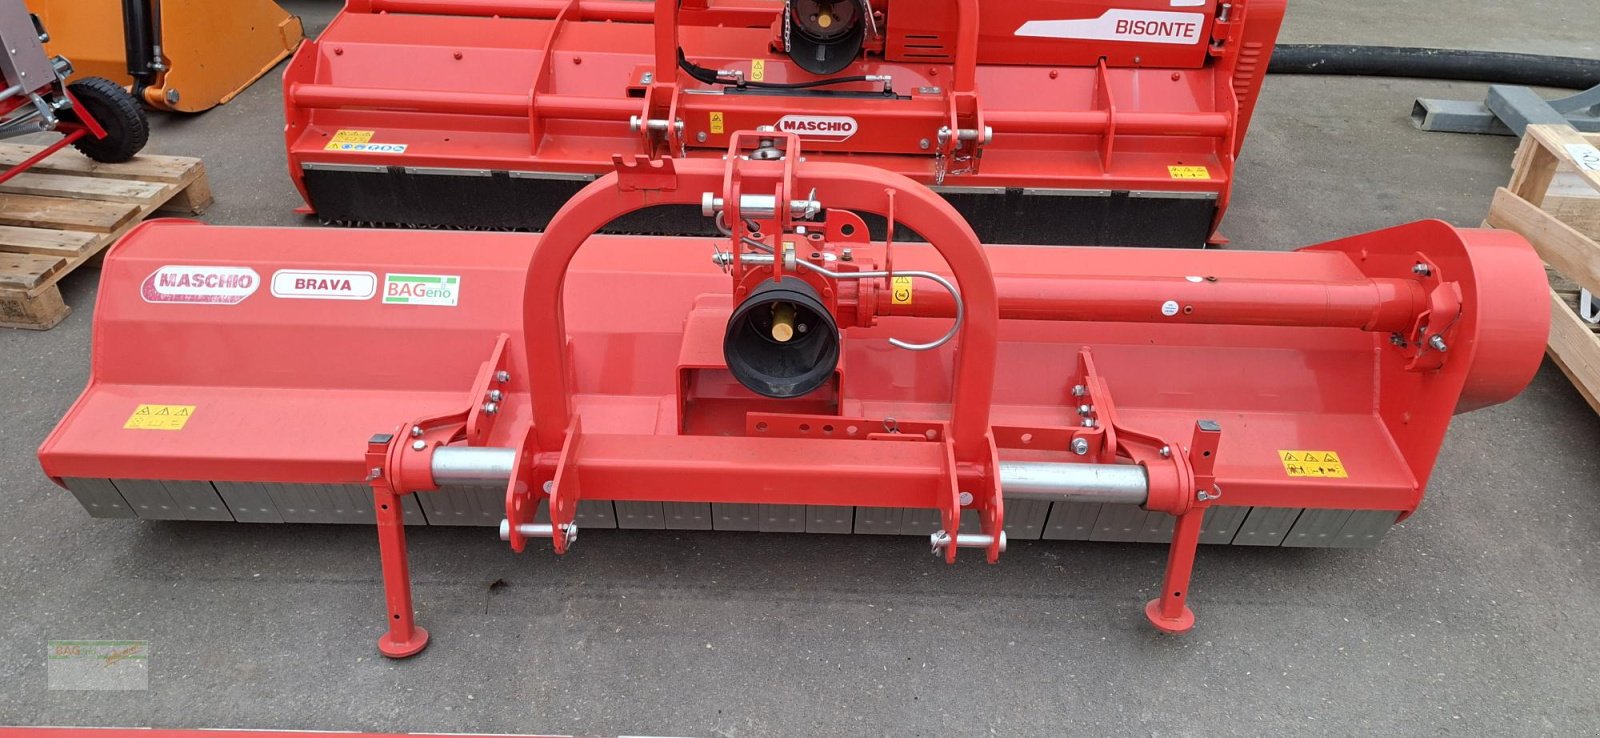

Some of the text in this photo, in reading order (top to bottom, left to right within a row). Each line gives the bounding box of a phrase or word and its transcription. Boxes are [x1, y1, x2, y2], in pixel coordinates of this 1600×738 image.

[1115, 19, 1196, 37] BISONTE
[784, 120, 852, 132] MASCHIO
[159, 272, 253, 289] MASCHIO
[295, 278, 351, 291] BRAVA
[388, 282, 452, 298] BAGeno
